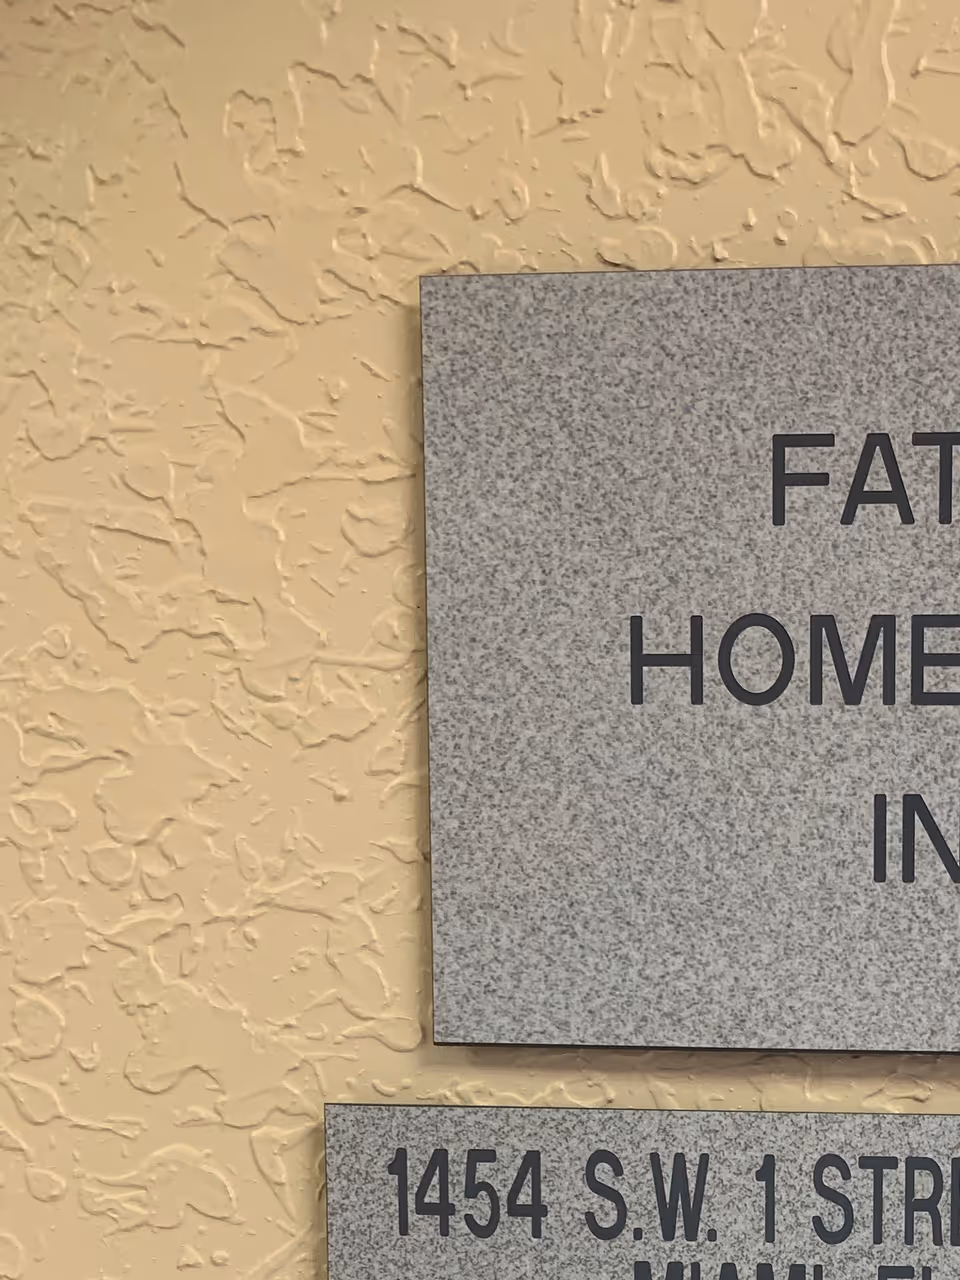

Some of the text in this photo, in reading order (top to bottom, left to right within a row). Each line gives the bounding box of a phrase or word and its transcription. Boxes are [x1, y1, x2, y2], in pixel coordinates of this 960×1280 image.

[386, 1147, 549, 1239] 1454
[584, 1149, 718, 1243] S.W.
[755, 1154, 776, 1243] 1
